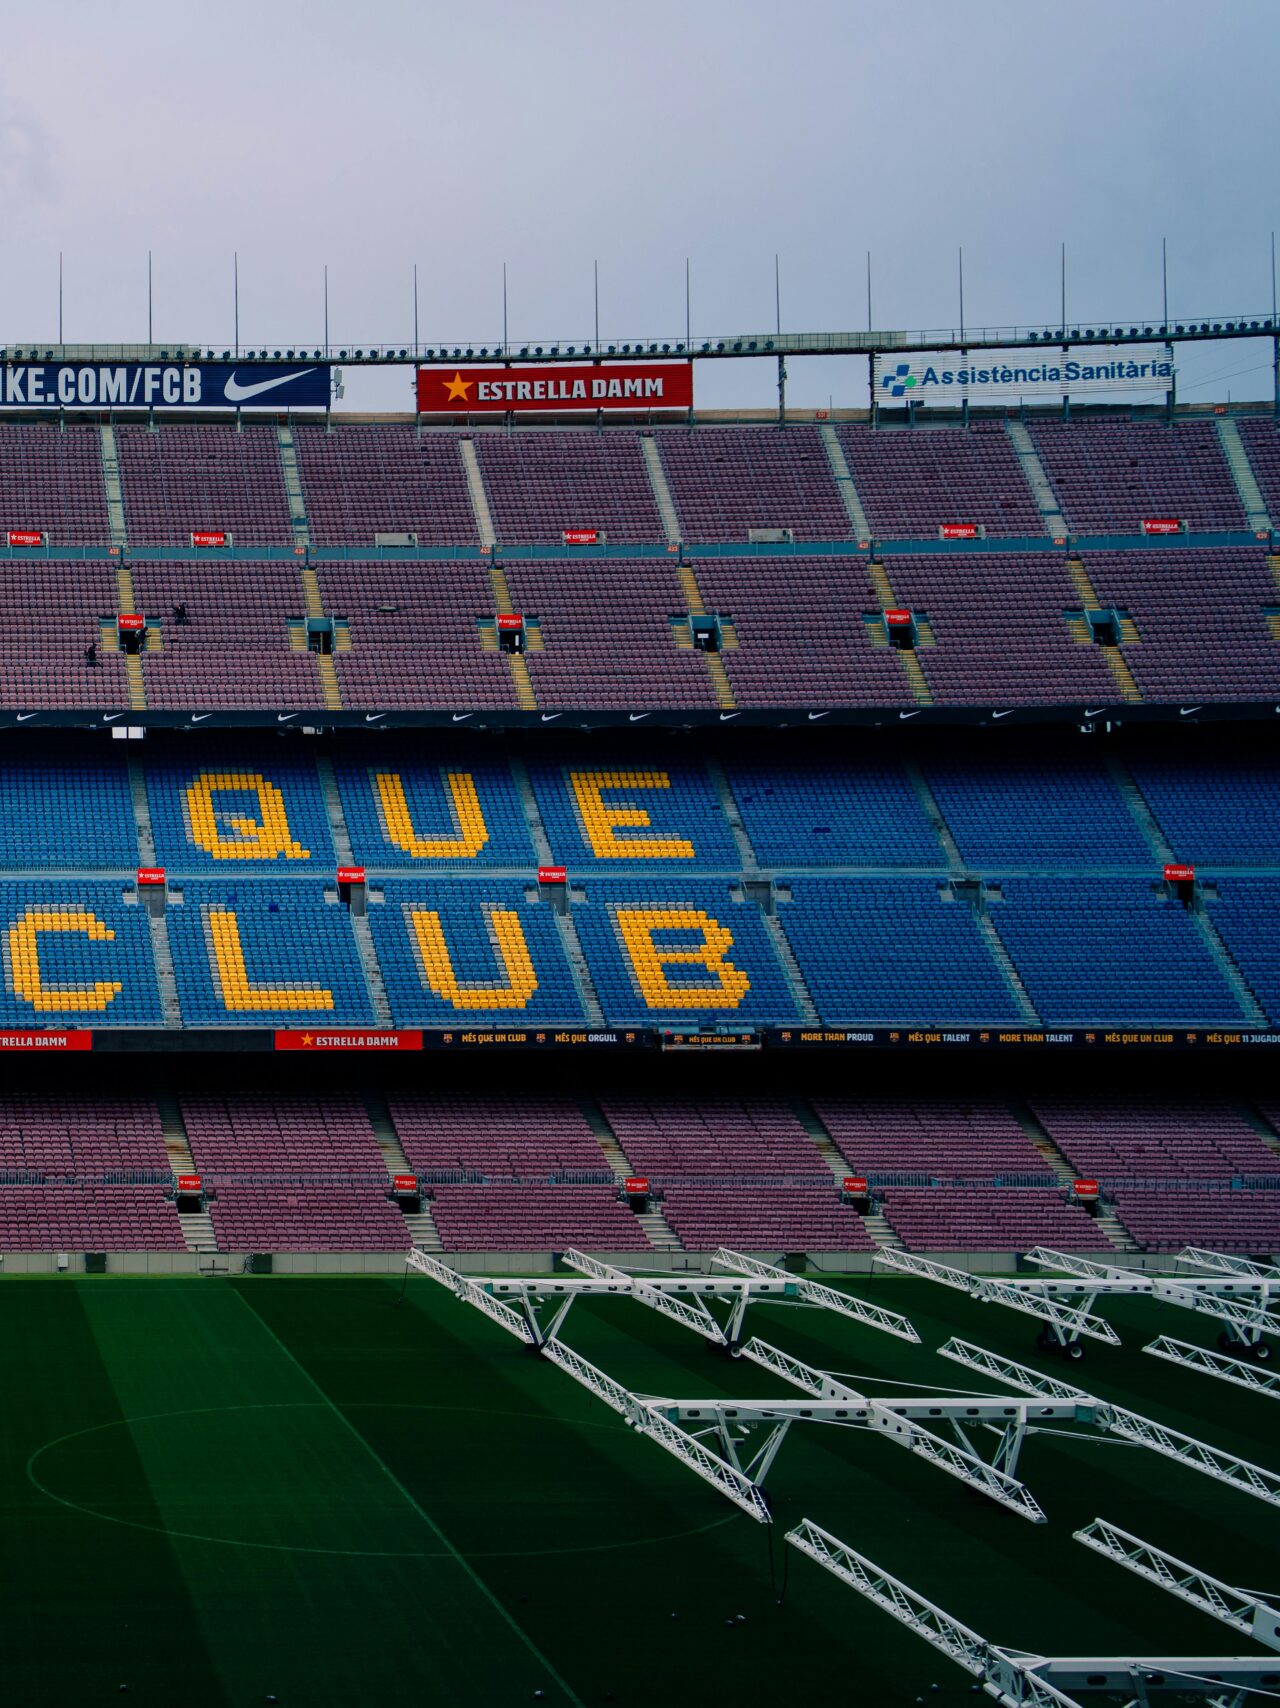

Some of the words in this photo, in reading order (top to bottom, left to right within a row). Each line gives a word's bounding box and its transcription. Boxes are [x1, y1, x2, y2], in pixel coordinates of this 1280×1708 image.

[921, 364, 1061, 386] Assistència
[1064, 359, 1172, 382] Sanitària
[477, 379, 587, 401] ESTRELLA
[591, 377, 664, 399] DAMM
[186, 771, 696, 859] QUE
[9, 910, 752, 1012] CLUB
[35, 1037, 67, 1047] DAMM
[316, 1036, 365, 1046] ESTRELLA
[366, 1036, 398, 1046] DAMM
[461, 1033, 477, 1043] MÉS
[477, 1034, 494, 1044] QUE
[494, 1034, 507, 1043] UN
[507, 1034, 527, 1043] CLUB
[554, 1033, 570, 1042] MÉS
[570, 1034, 587, 1044] QUE
[588, 1034, 618, 1042] ORGULL
[700, 1036, 712, 1044] QUE
[800, 1032, 823, 1041] MORE
[823, 1032, 846, 1041] THAN
[846, 1032, 874, 1041] PROUD
[908, 1032, 924, 1042] MÉS
[924, 1033, 941, 1043] QUE
[942, 1033, 971, 1042] TALENT
[999, 1033, 1022, 1042] MORE
[1022, 1033, 1044, 1042] THAN
[1045, 1033, 1074, 1042] TALENT
[1105, 1033, 1121, 1043] MÉS
[1122, 1034, 1139, 1044] QUE
[1139, 1034, 1152, 1043] UN
[1153, 1034, 1174, 1043] CLUB
[1206, 1033, 1223, 1043] MÉS
[1223, 1034, 1241, 1044] QUE
[1241, 1034, 1249, 1043] 11
